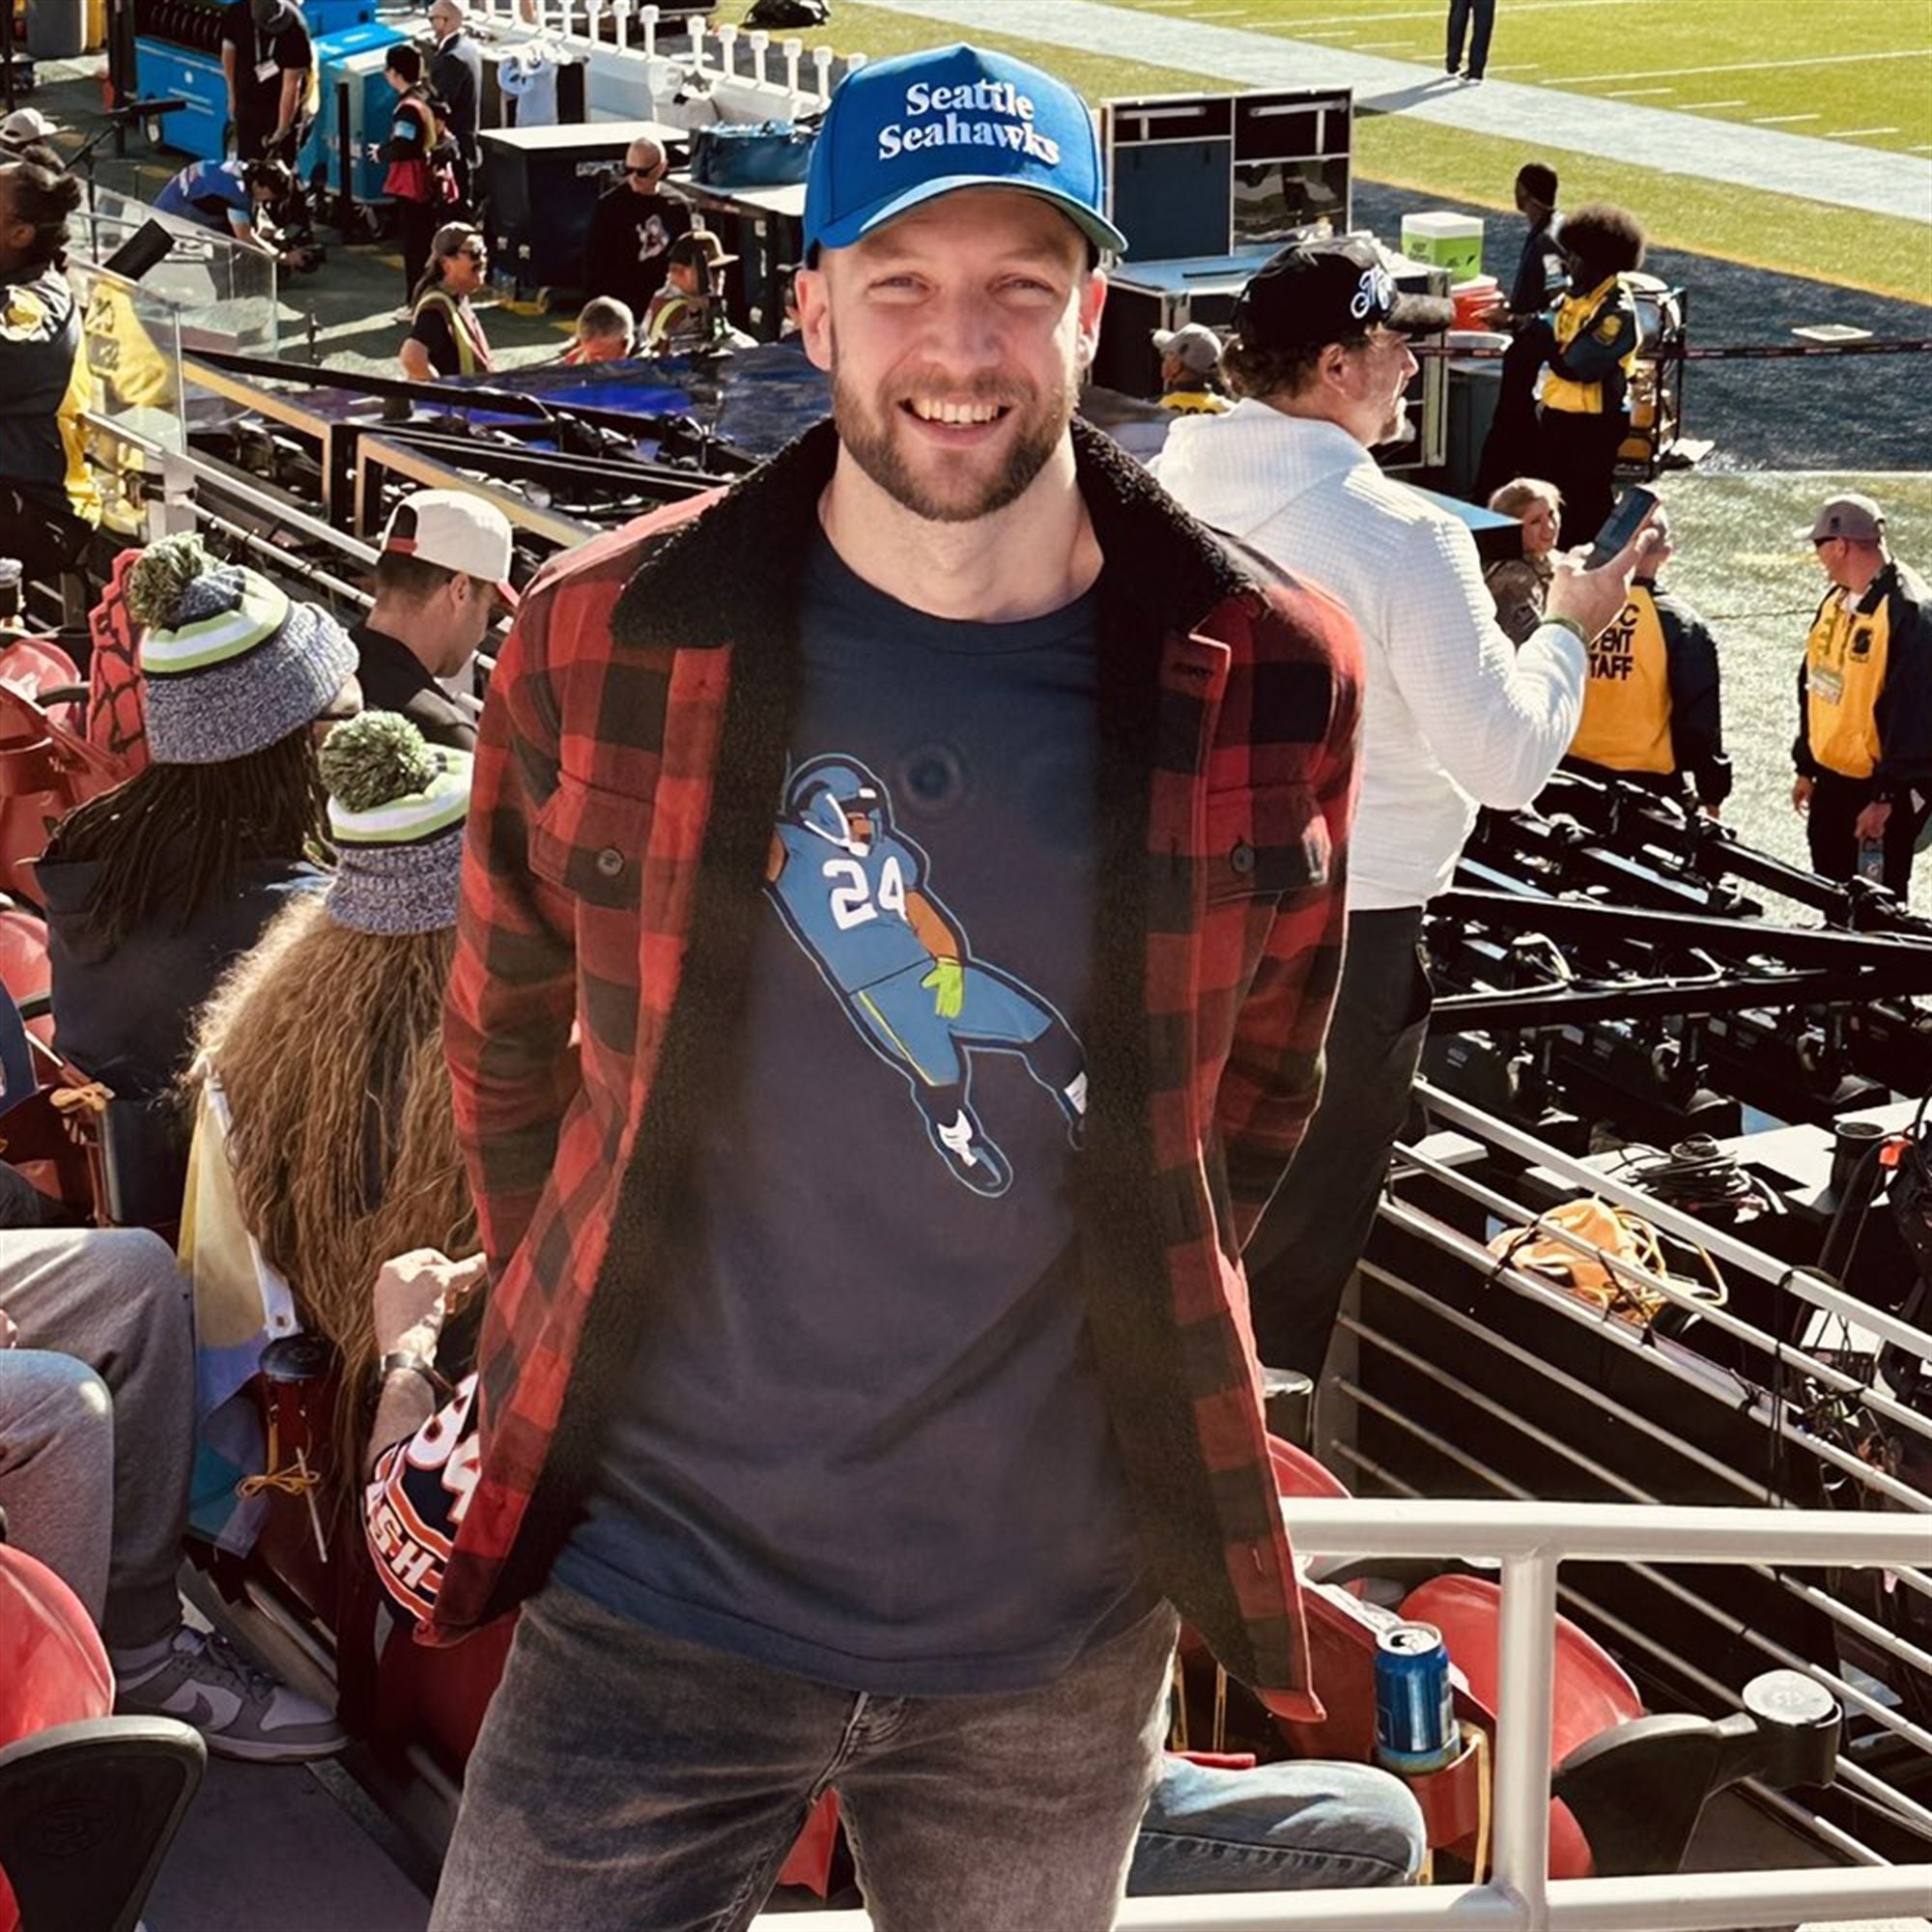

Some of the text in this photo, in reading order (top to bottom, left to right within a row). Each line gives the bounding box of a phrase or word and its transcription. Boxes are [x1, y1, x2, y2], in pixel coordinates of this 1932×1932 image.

[905, 78, 1035, 121] Seattle
[877, 112, 1061, 165] Seahawks
[1590, 628, 1634, 653] ENT
[1588, 654, 1634, 681] TAFF
[822, 856, 909, 930] 24
